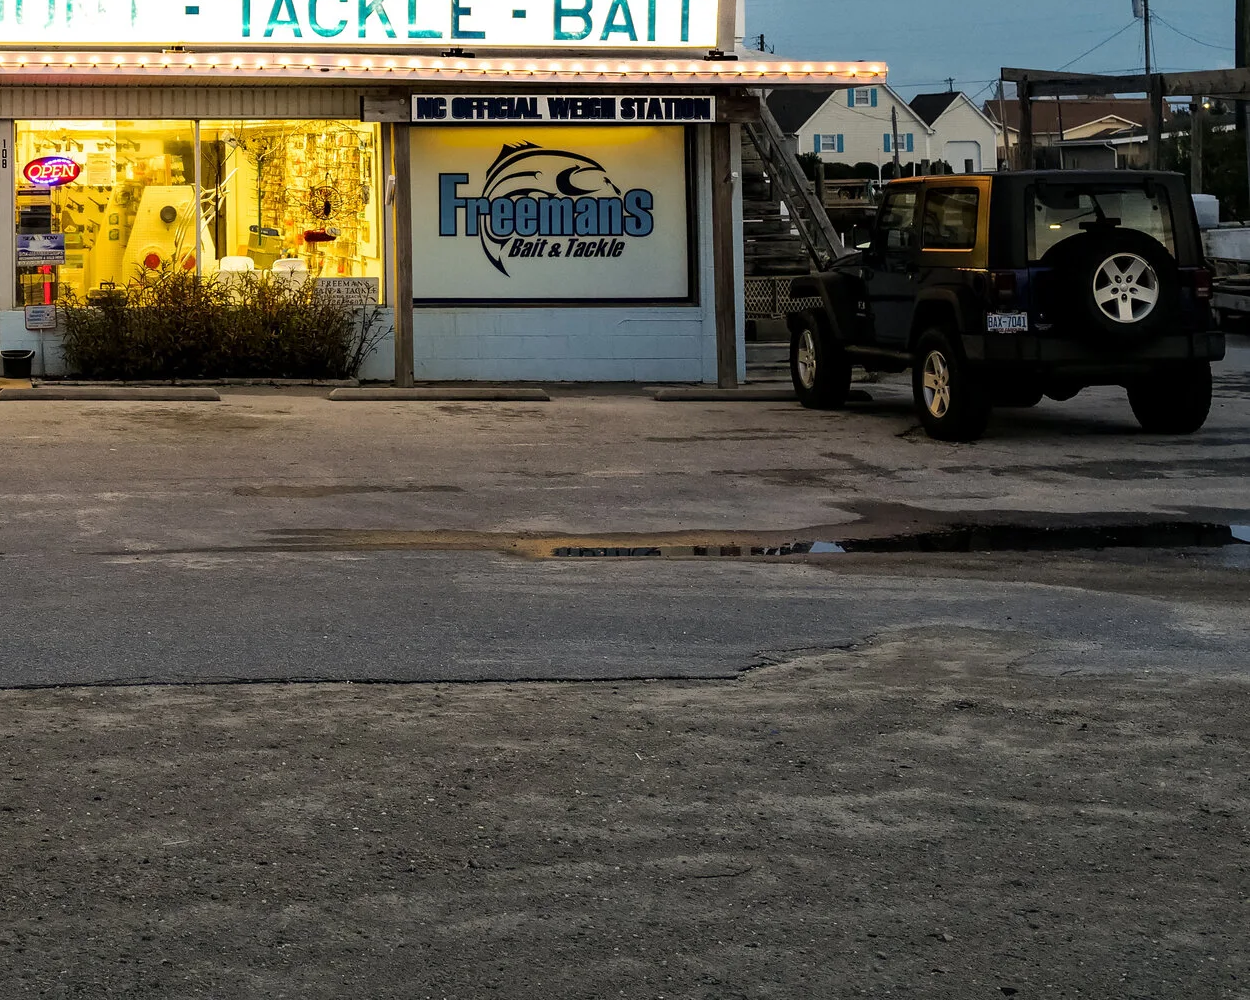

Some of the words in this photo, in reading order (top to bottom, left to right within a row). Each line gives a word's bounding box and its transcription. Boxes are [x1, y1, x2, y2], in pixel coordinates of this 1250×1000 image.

[416, 96, 447, 120] NC
[451, 96, 543, 120] OFFICIAL
[547, 96, 616, 120] WEIGH
[620, 96, 711, 121] STATION
[27, 163, 76, 180] OPEN
[508, 238, 547, 258] Bait
[564, 238, 626, 258] Tackle
[988, 316, 1026, 328] BAX-7041
